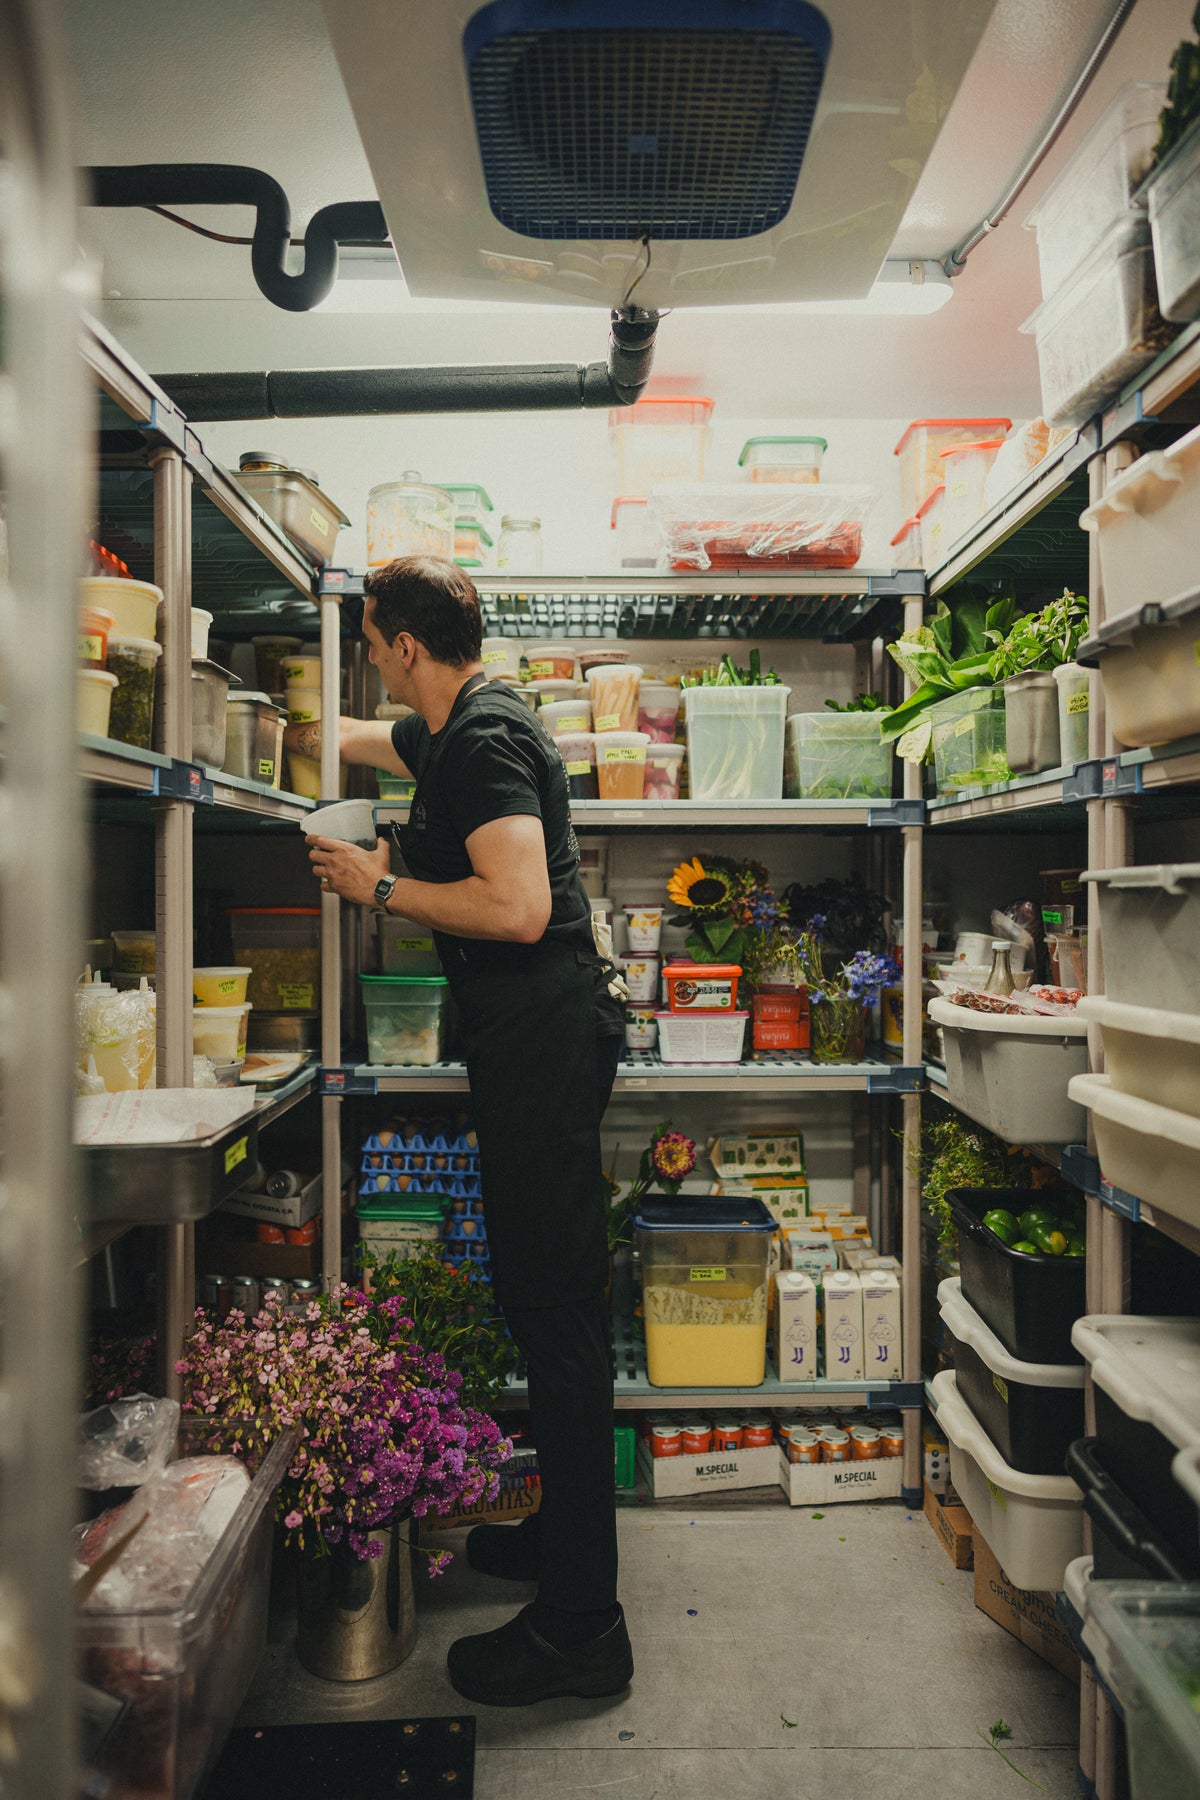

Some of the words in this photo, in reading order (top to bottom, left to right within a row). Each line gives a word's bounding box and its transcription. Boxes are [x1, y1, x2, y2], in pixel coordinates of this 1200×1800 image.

[281, 1207, 294, 1215] CA
[695, 1462, 740, 1477] M.SPECIAL
[834, 1471, 878, 1484] M.SPECIAL
[440, 1488, 534, 1519] AGUNITAS
[988, 1578, 1028, 1617] CREAM
